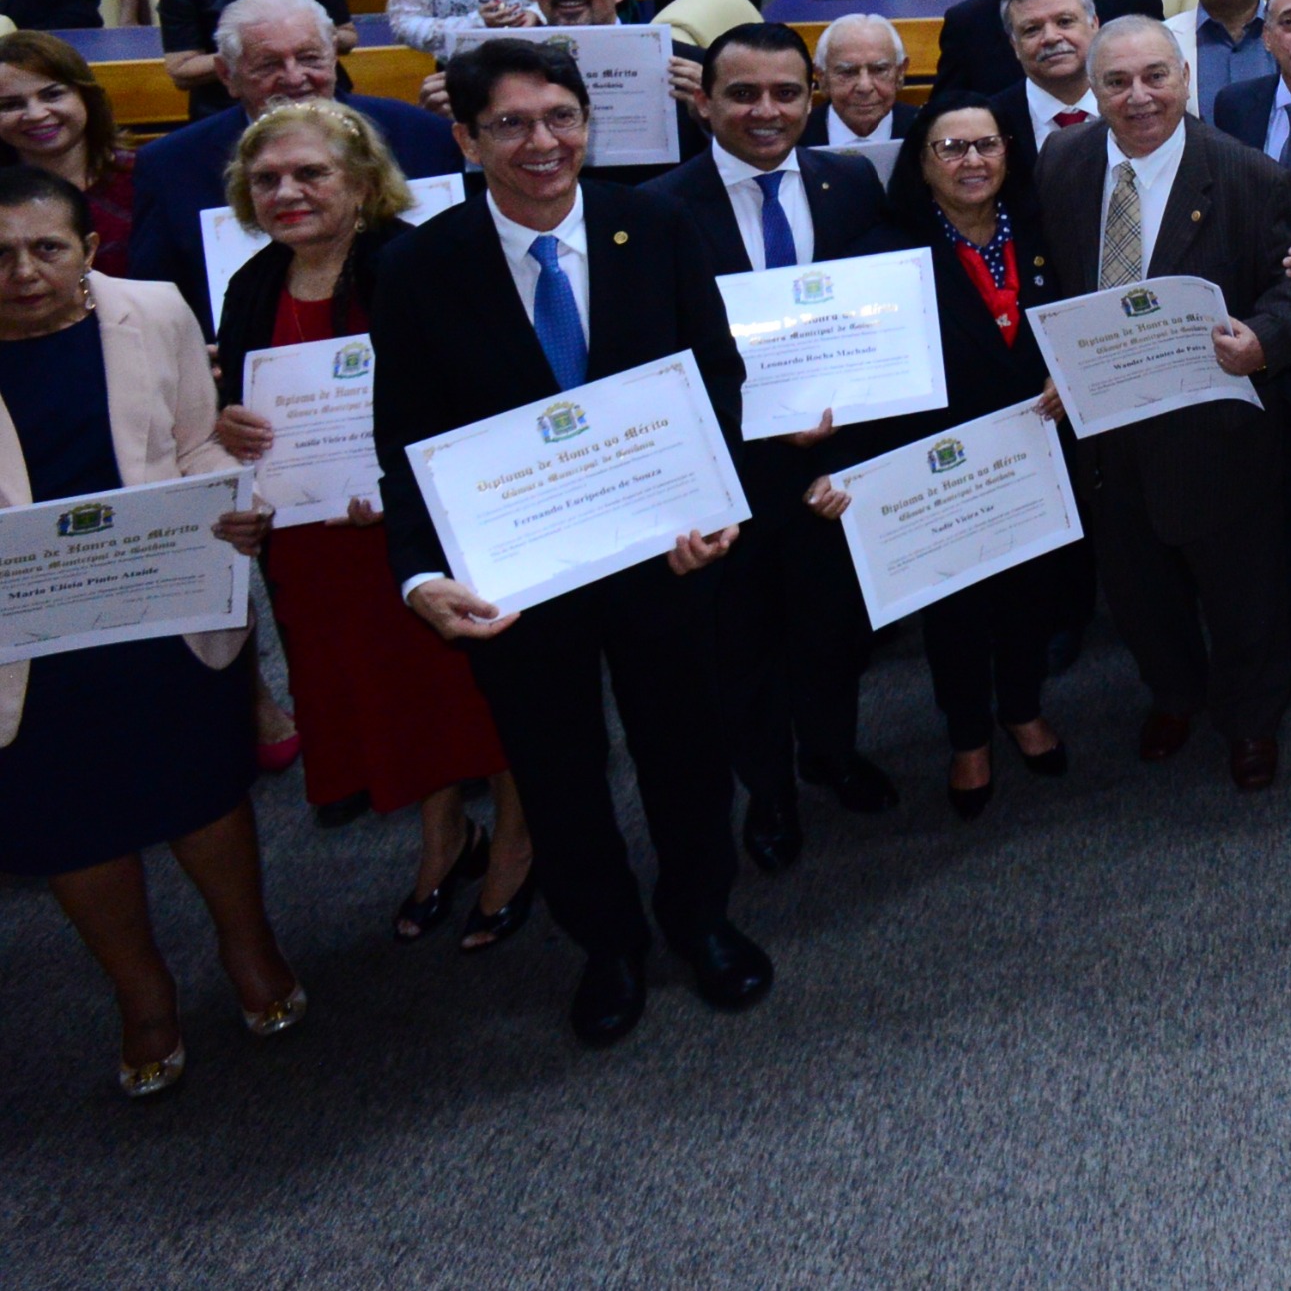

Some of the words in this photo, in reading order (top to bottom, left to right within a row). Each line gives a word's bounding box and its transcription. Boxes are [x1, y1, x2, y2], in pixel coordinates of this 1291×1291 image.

[477, 466, 533, 492] Diploma
[538, 460, 551, 471] de
[558, 442, 600, 463] Honra
[604, 436, 619, 447] ao
[625, 418, 669, 440] Mérito
[881, 496, 923, 516] Diploma
[928, 488, 937, 496] de
[943, 474, 974, 490] Honra
[993, 452, 1027, 470] Mérito
[43, 550, 59, 558] de
[123, 535, 140, 544] ao
